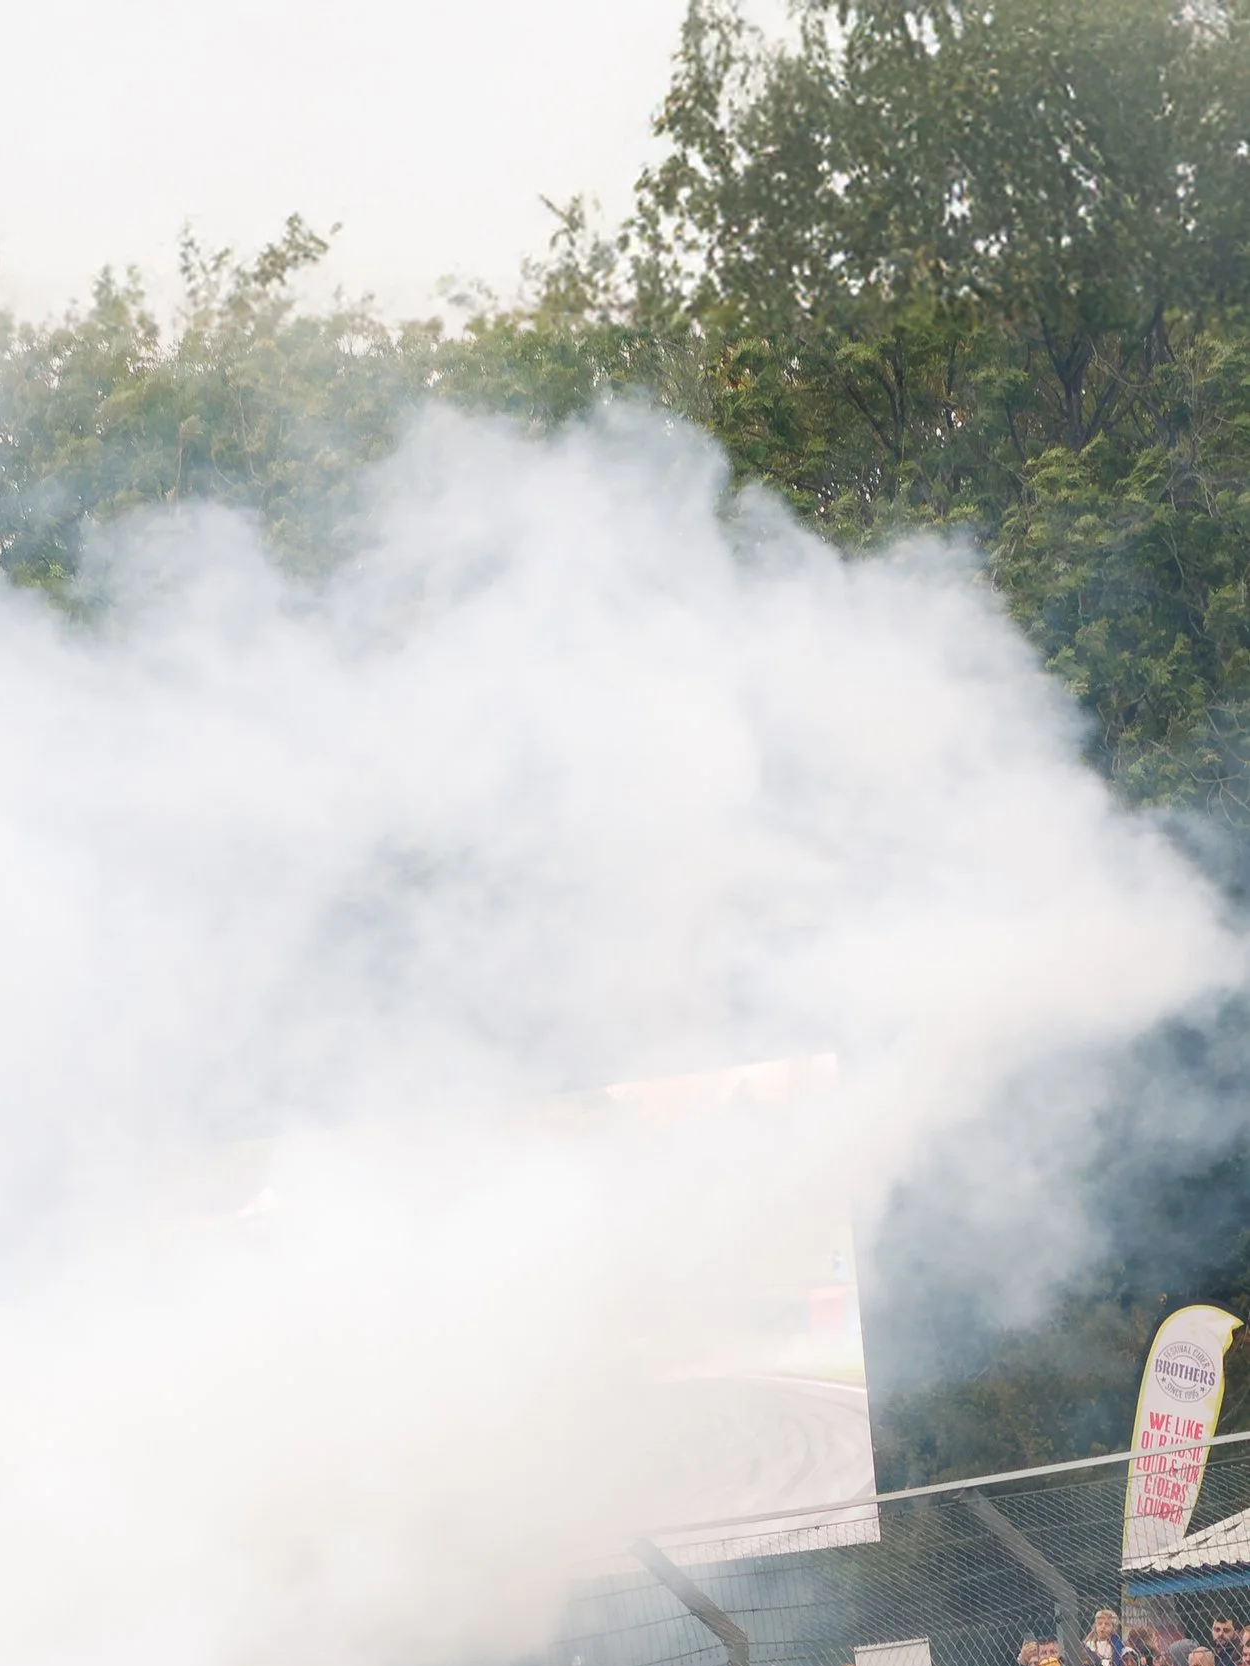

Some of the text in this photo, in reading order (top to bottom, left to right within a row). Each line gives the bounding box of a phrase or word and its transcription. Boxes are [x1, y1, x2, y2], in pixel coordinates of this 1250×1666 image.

[1155, 1358, 1216, 1387] BROTHERS
[1163, 1344, 1213, 1374] FESTIVAL CIDER
[1165, 1382, 1183, 1399] SINCE
[1149, 1410, 1205, 1441] WE LIKE
[1136, 1455, 1201, 1485] LOUD & OUR
[1144, 1475, 1187, 1504] CIDERS
